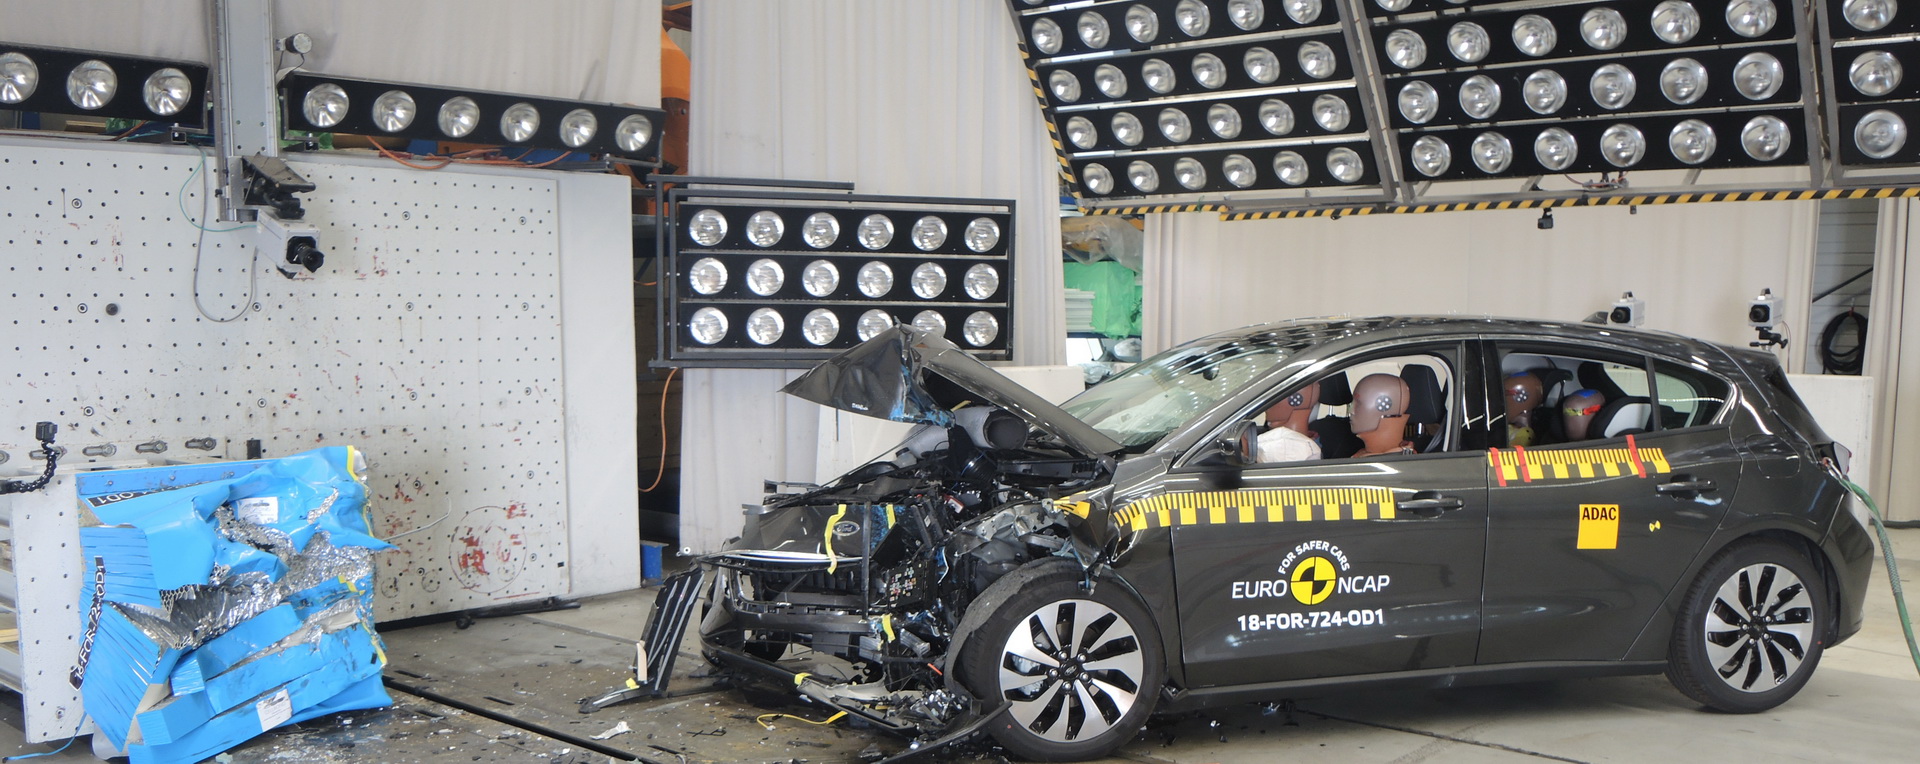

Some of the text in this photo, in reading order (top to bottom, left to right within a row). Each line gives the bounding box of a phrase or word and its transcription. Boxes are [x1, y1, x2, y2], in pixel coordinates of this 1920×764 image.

[1581, 507, 1617, 521] ADAC
[1278, 540, 1350, 575] FOR SAFER CARS
[1231, 574, 1390, 599] EURO NCAP
[1237, 608, 1384, 632] 18-FOR-724-OD1
